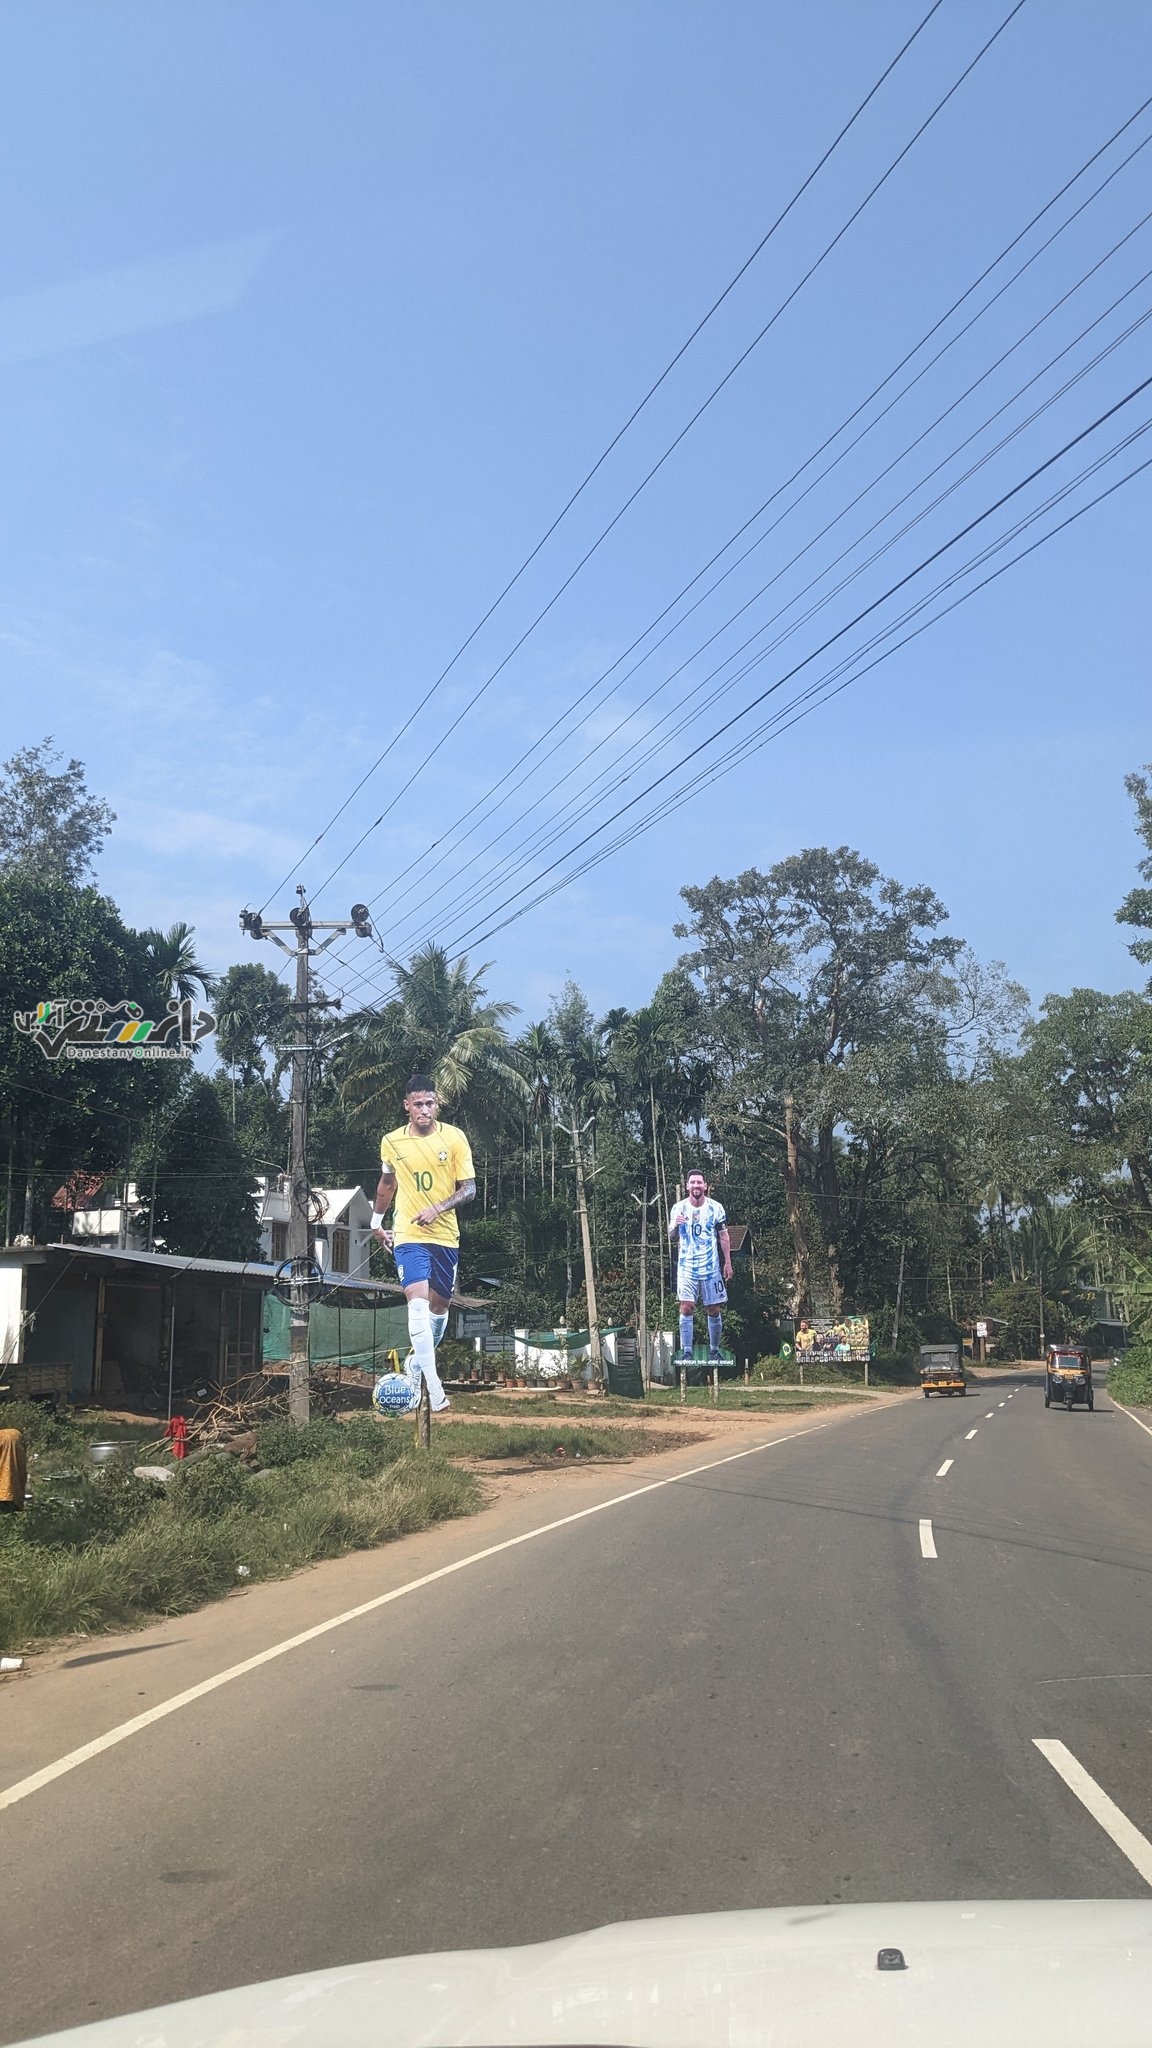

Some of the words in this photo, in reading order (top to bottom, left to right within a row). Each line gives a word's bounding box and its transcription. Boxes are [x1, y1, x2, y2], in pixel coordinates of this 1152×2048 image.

[414, 1171, 433, 1191] 10
[691, 1223, 702, 1237] 10
[713, 1280, 724, 1294] 10
[384, 1384, 406, 1395] Blue
